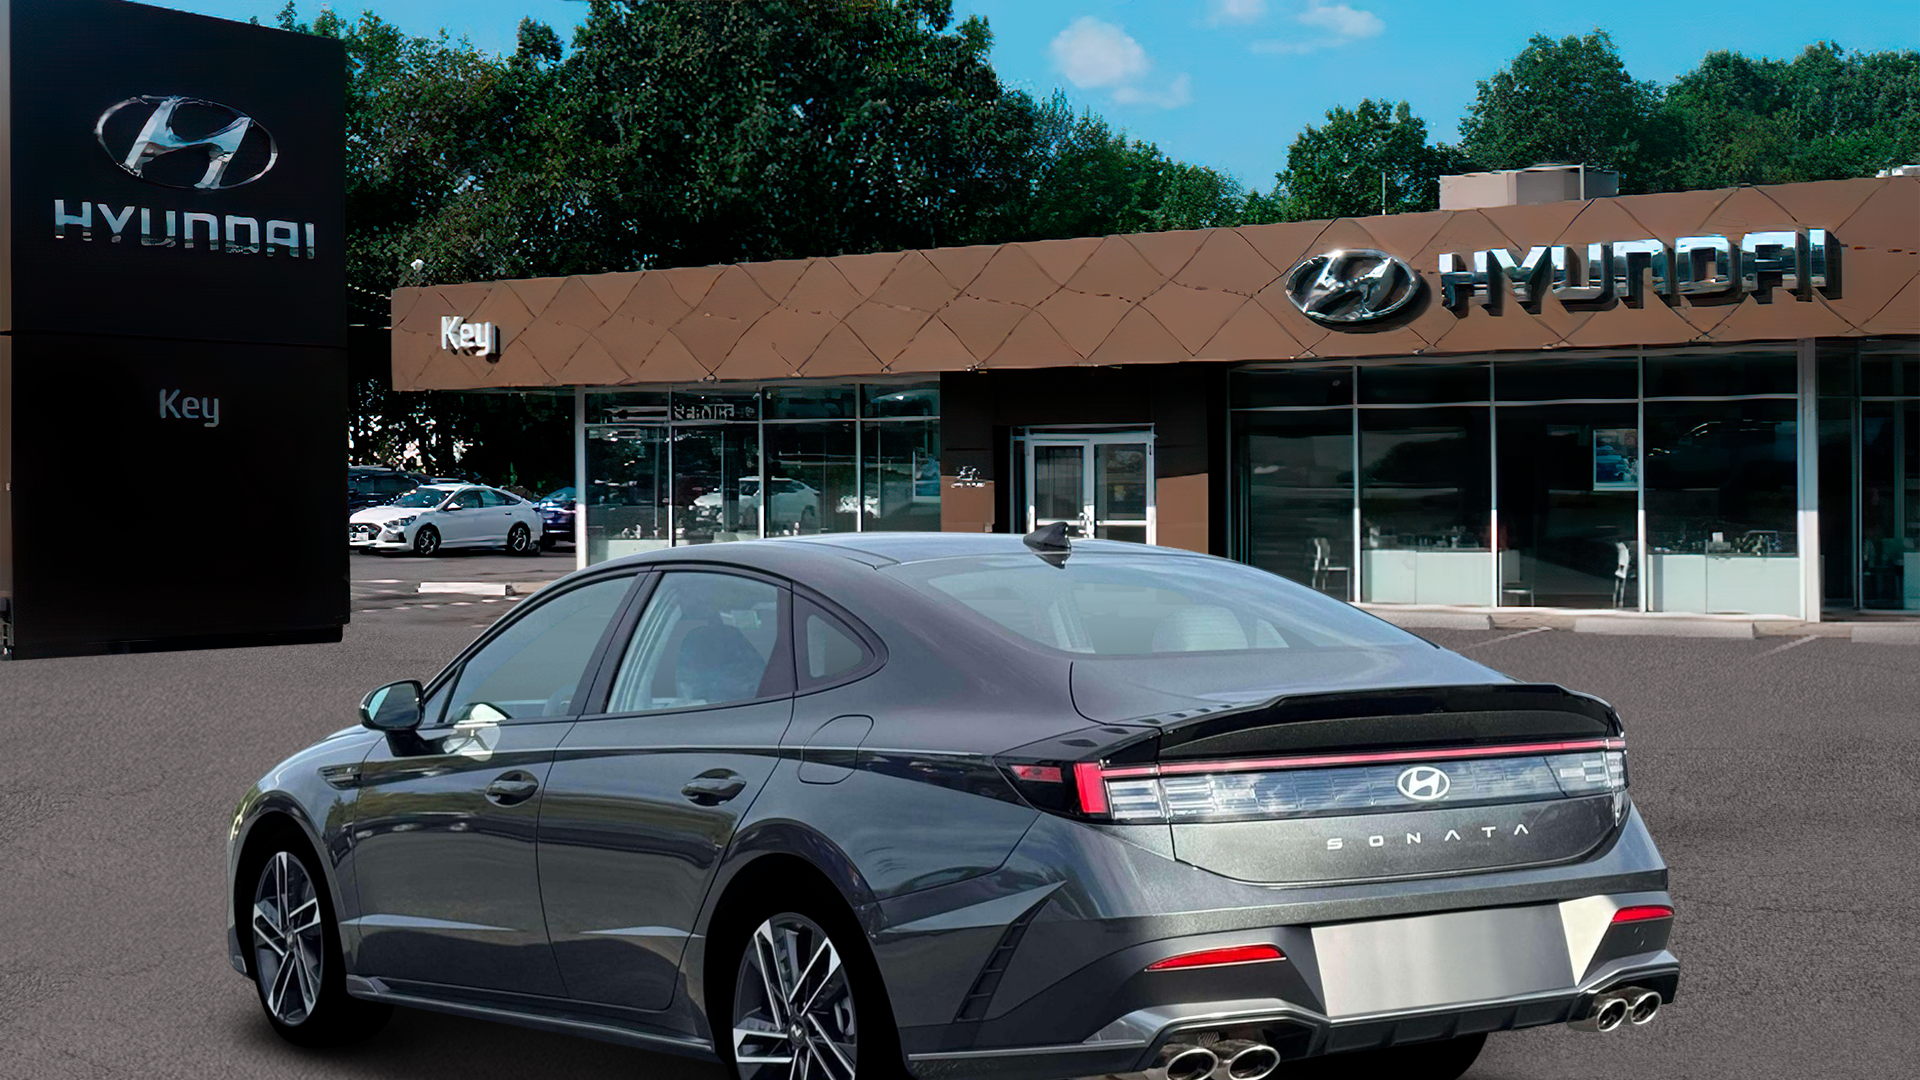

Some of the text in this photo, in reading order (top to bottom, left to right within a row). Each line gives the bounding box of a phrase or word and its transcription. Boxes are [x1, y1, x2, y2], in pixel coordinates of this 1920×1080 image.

[55, 199, 315, 259] HYUNDAI
[1438, 228, 1840, 312] HYUNDAI
[441, 315, 493, 357] Key
[159, 388, 220, 427] Key
[1326, 823, 1529, 850] SONATA
